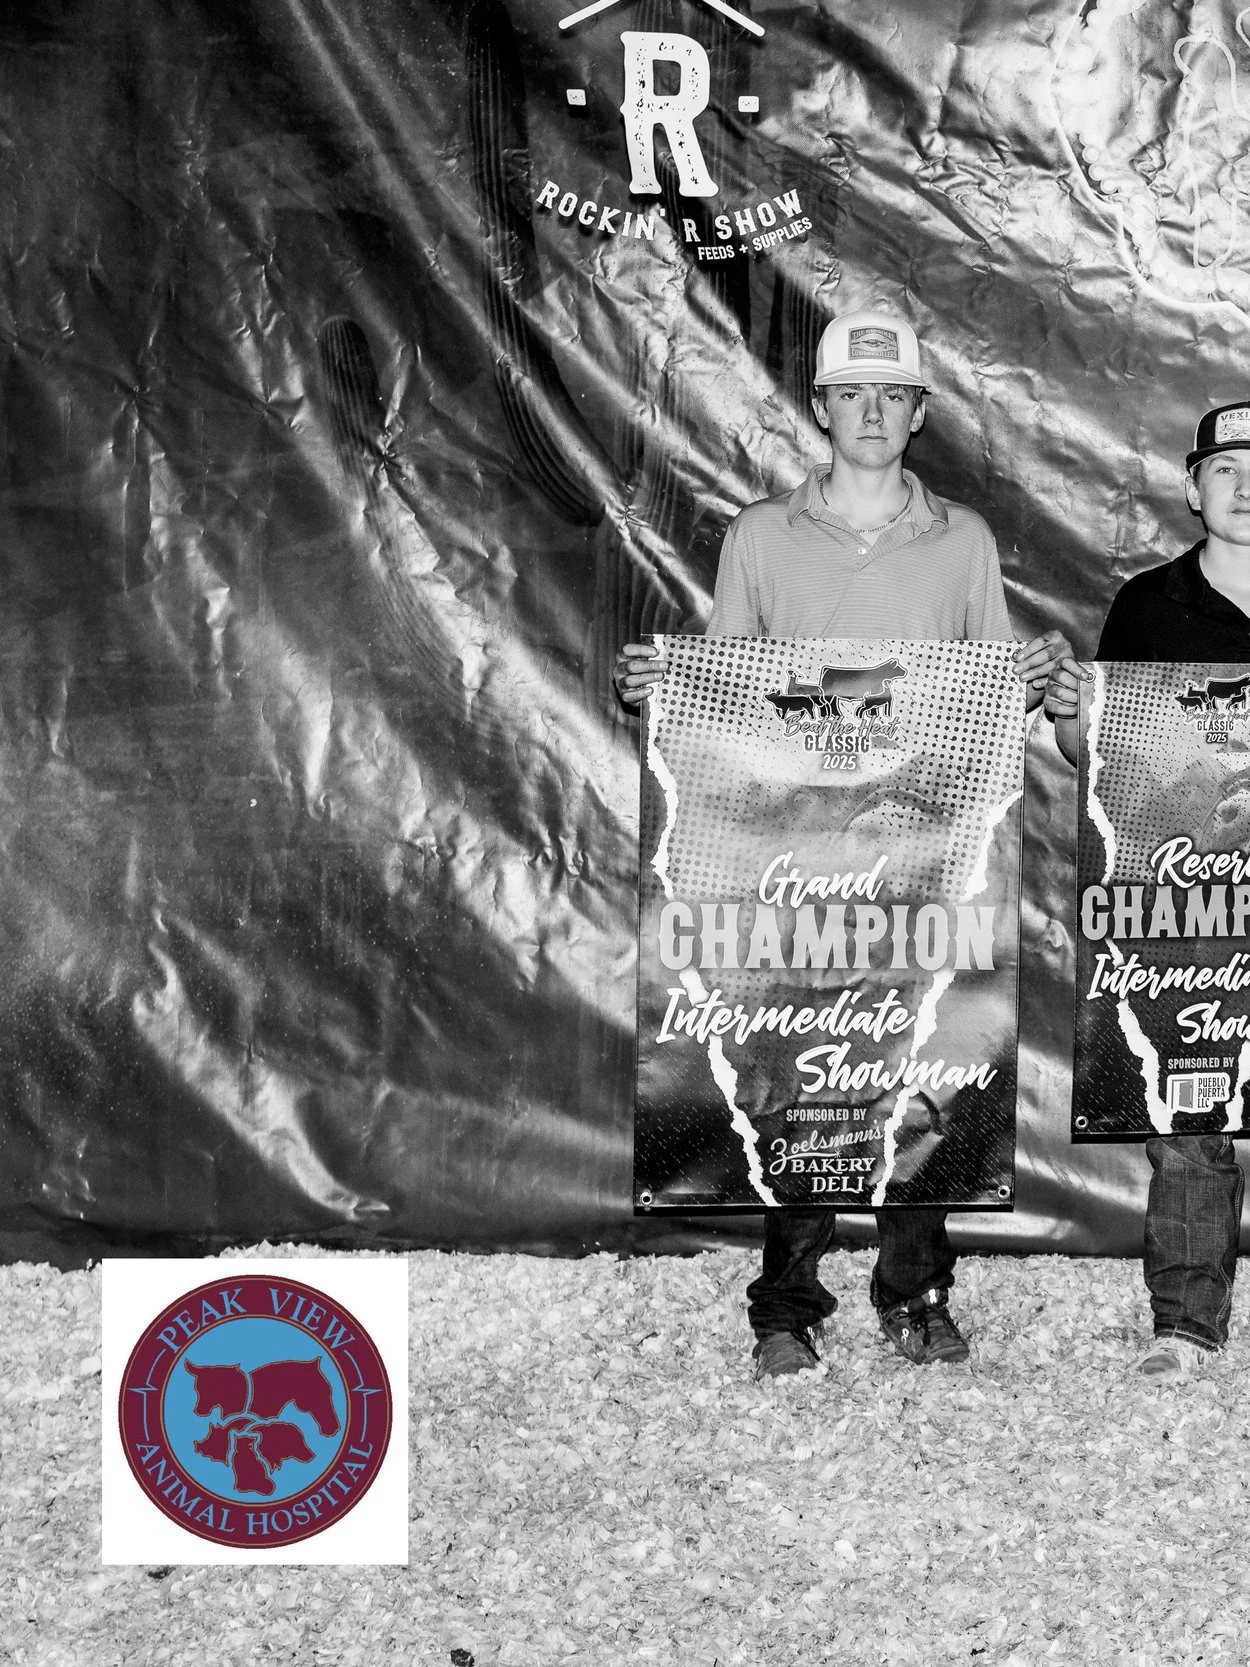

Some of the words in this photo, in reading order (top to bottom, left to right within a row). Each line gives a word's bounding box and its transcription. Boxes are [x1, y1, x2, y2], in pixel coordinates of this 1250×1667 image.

[620, 31, 719, 197] R
[535, 180, 666, 241] ROCKIN'
[682, 218, 701, 243] R
[714, 188, 803, 240] SHOW
[698, 245, 735, 261] FEEDS
[752, 216, 813, 252] SUPPLIES
[784, 714, 828, 737] Beat
[828, 714, 857, 736] the
[857, 715, 901, 741] Heat
[1197, 720, 1234, 732] CLASSIC
[804, 735, 871, 753] CLASSIC
[1206, 733, 1228, 743] 2025
[822, 754, 858, 771] 2025
[758, 851, 889, 909] Grand
[657, 902, 998, 971] CHAMPION
[656, 988, 916, 1046] Intermediate
[795, 1041, 997, 1094] Showman
[1167, 1057, 1220, 1069] SPONSORED
[1222, 1056, 1235, 1068] BY
[1197, 1076, 1226, 1087] PUEBLO
[1197, 1087, 1226, 1098] PUERTA
[1197, 1098, 1210, 1108] LLC
[786, 1108, 850, 1122] SPONSORED
[852, 1108, 868, 1121] BY
[790, 1157, 876, 1174] BAKERY
[811, 1176, 865, 1194] DELI
